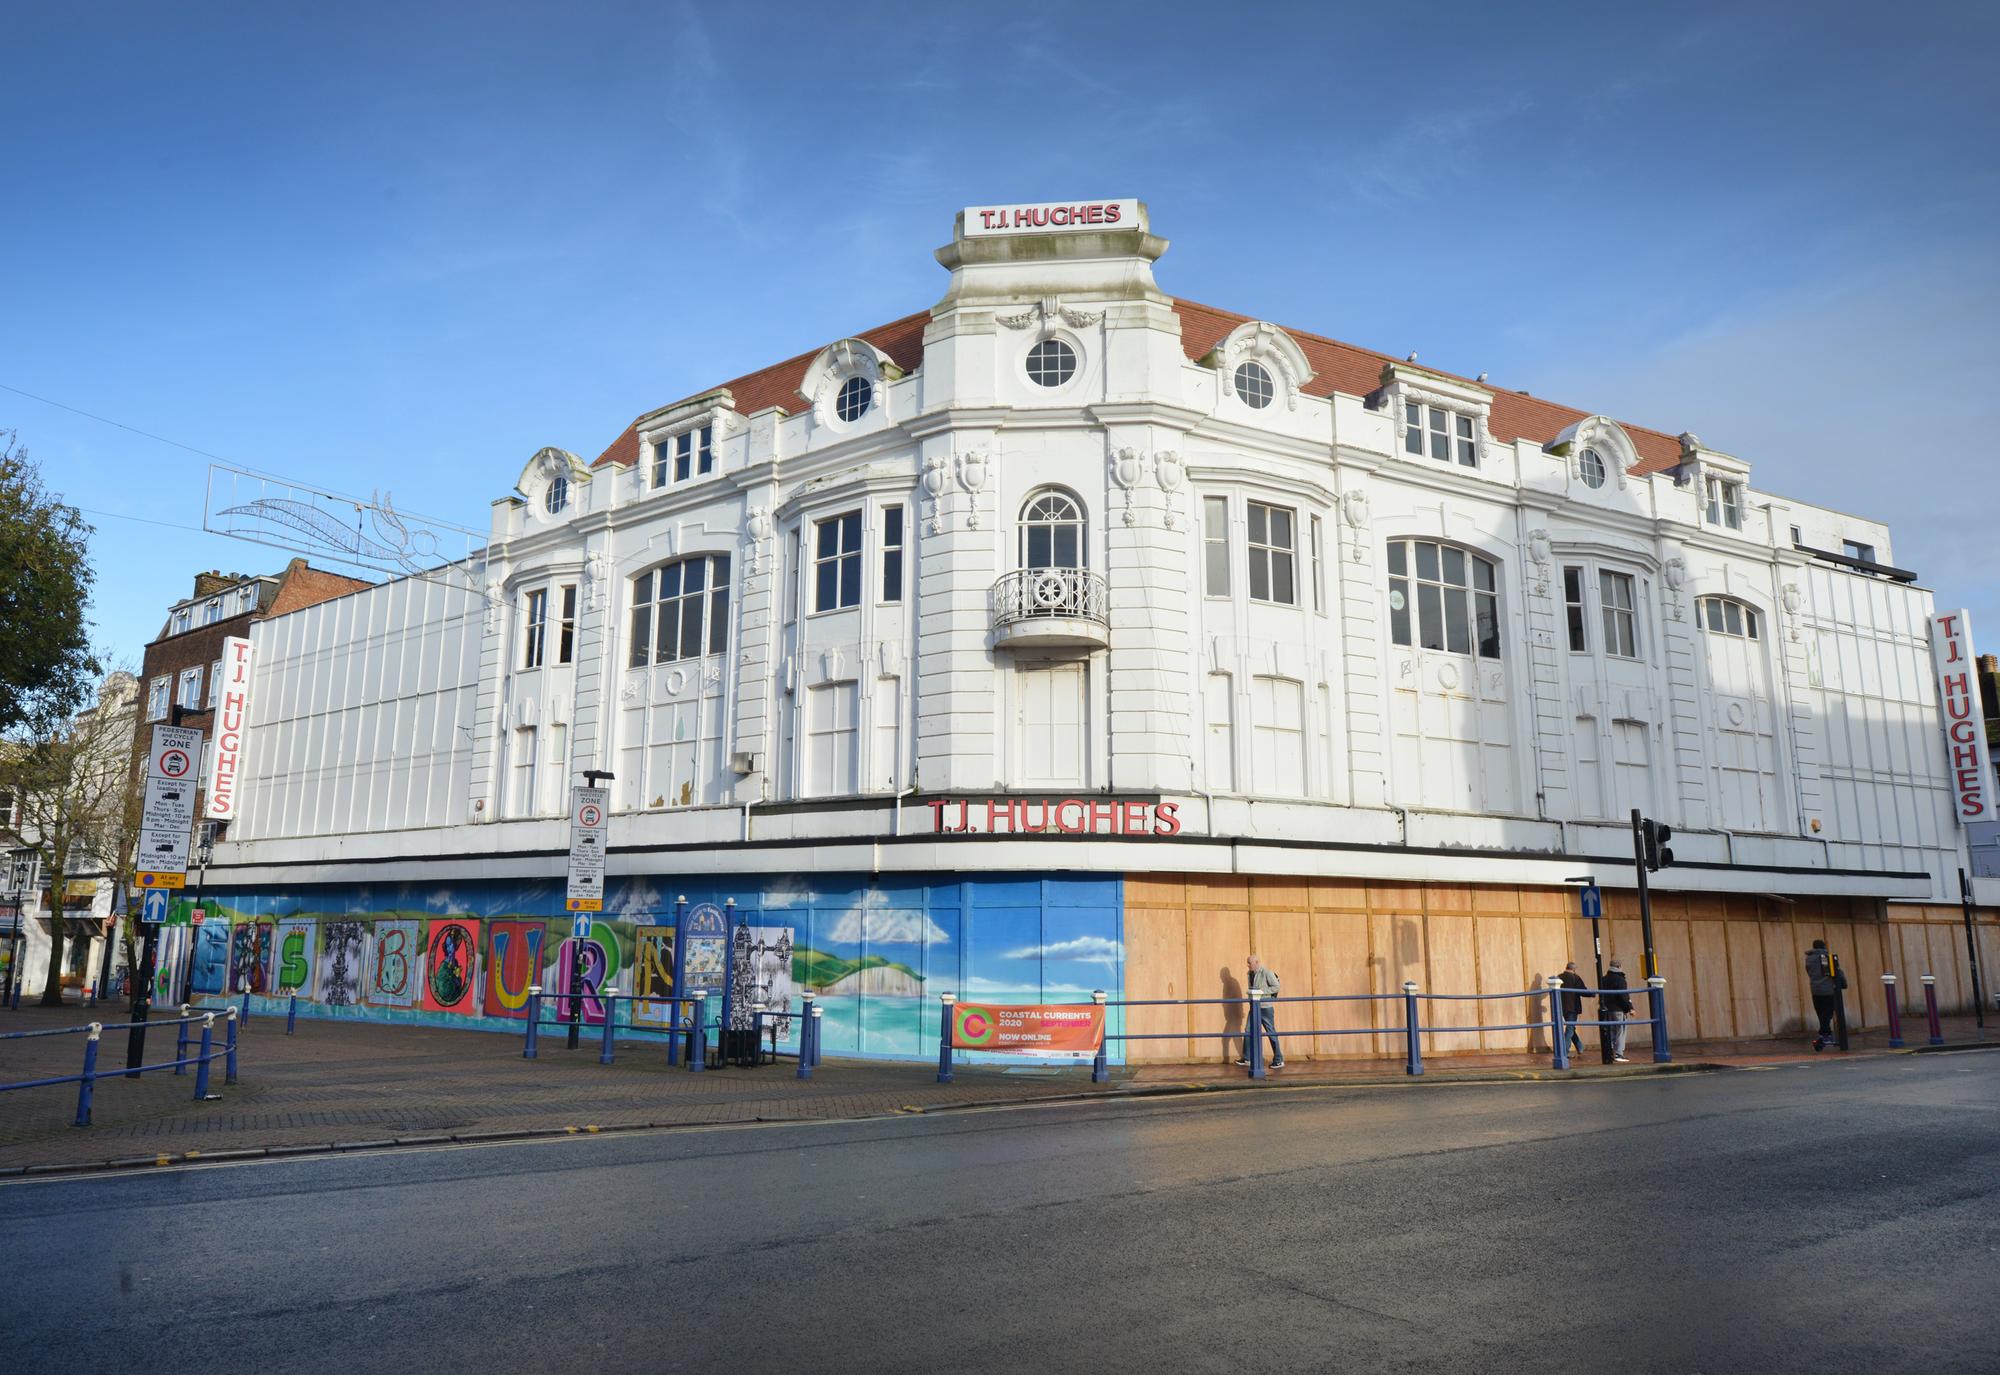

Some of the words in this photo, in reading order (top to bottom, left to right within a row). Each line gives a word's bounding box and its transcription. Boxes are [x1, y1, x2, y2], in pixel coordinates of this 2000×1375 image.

[980, 208, 1010, 230] T.J.
[1014, 203, 1122, 228] HUGHES
[158, 726, 199, 736] PEDESTRIAN
[174, 733, 194, 741] CYCLE
[162, 738, 192, 749] ZONE
[1943, 672, 1985, 816] HUGHES
[213, 691, 244, 814] HUGHES
[156, 785, 178, 793] loading
[580, 797, 601, 805] ZONE
[145, 811, 171, 819] Midnight
[928, 799, 977, 834] T.J.
[986, 798, 1182, 836] HUGHES
[140, 852, 166, 860] Midnight
[999, 1010, 1042, 1020] COASTAL
[1043, 1011, 1092, 1020] CURRENTS
[998, 1019, 1023, 1028] 2020
[998, 1033, 1020, 1042] NOW
[1020, 1033, 1052, 1042] ONLINE
